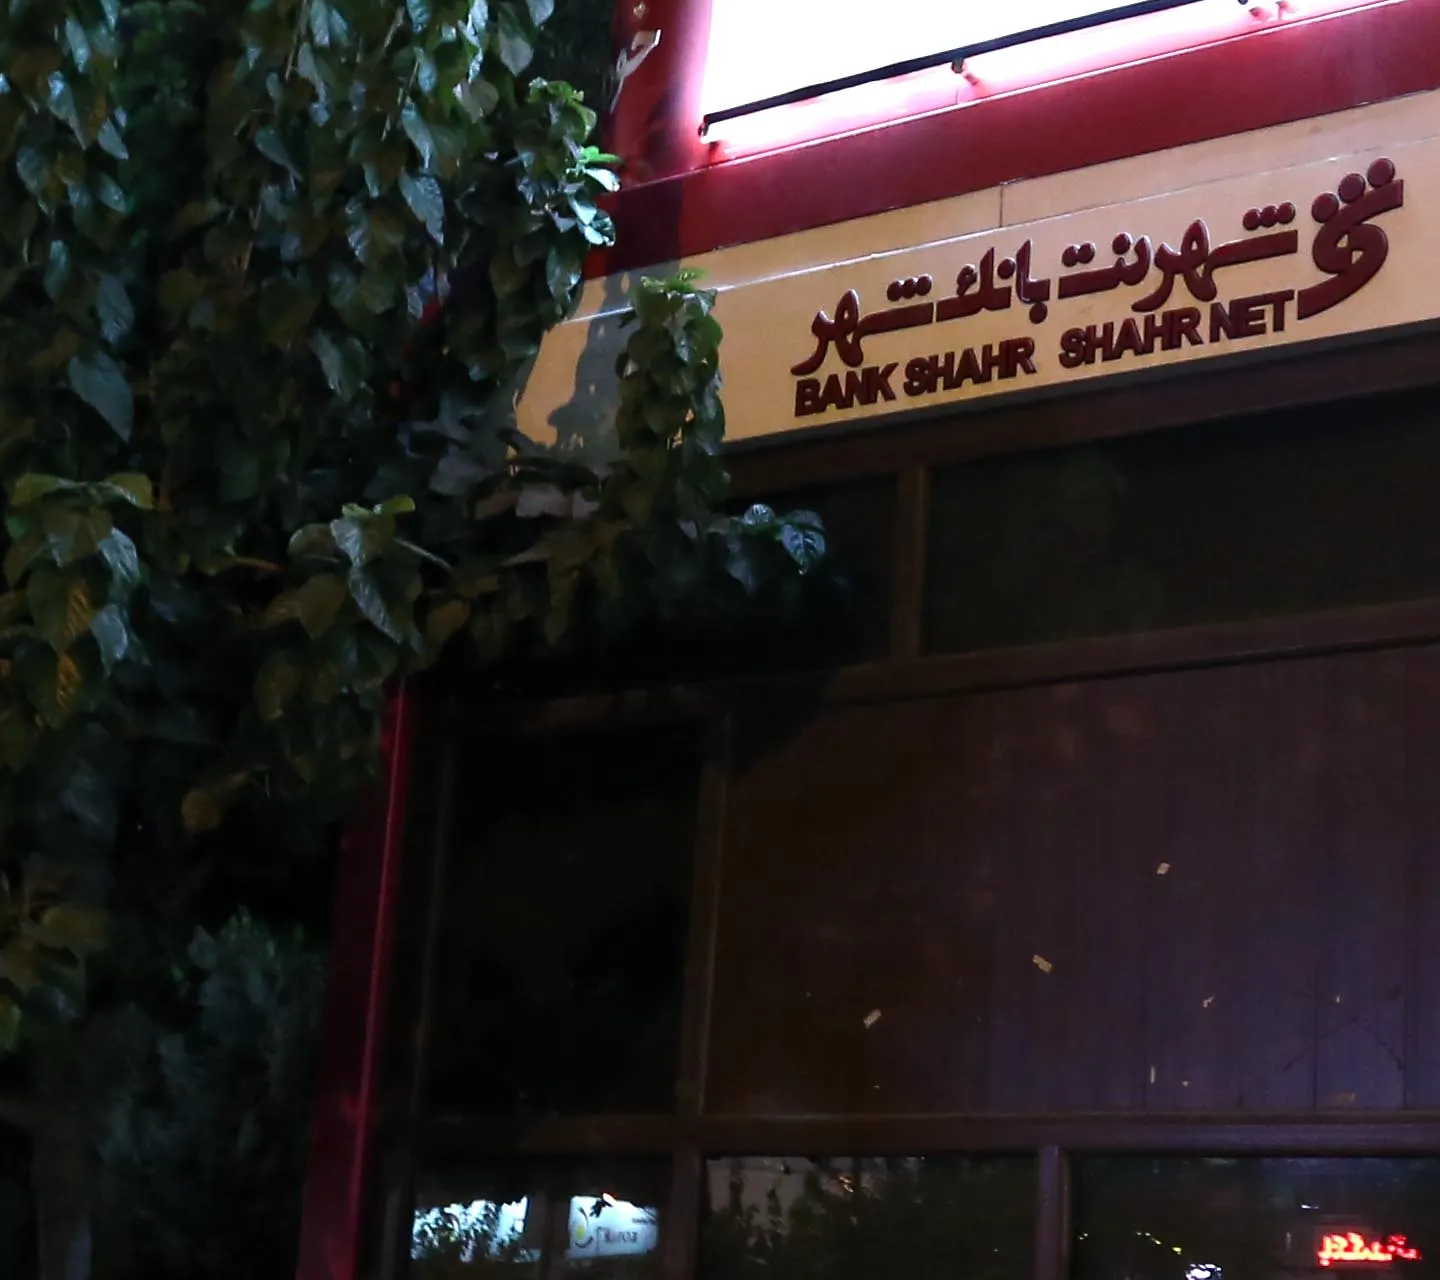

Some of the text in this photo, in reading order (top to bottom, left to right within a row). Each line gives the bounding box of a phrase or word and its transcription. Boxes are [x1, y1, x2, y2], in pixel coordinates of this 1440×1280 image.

[790, 273, 934, 376] شهر
[795, 289, 1294, 417] BANK SHAHR SHAHR NET
